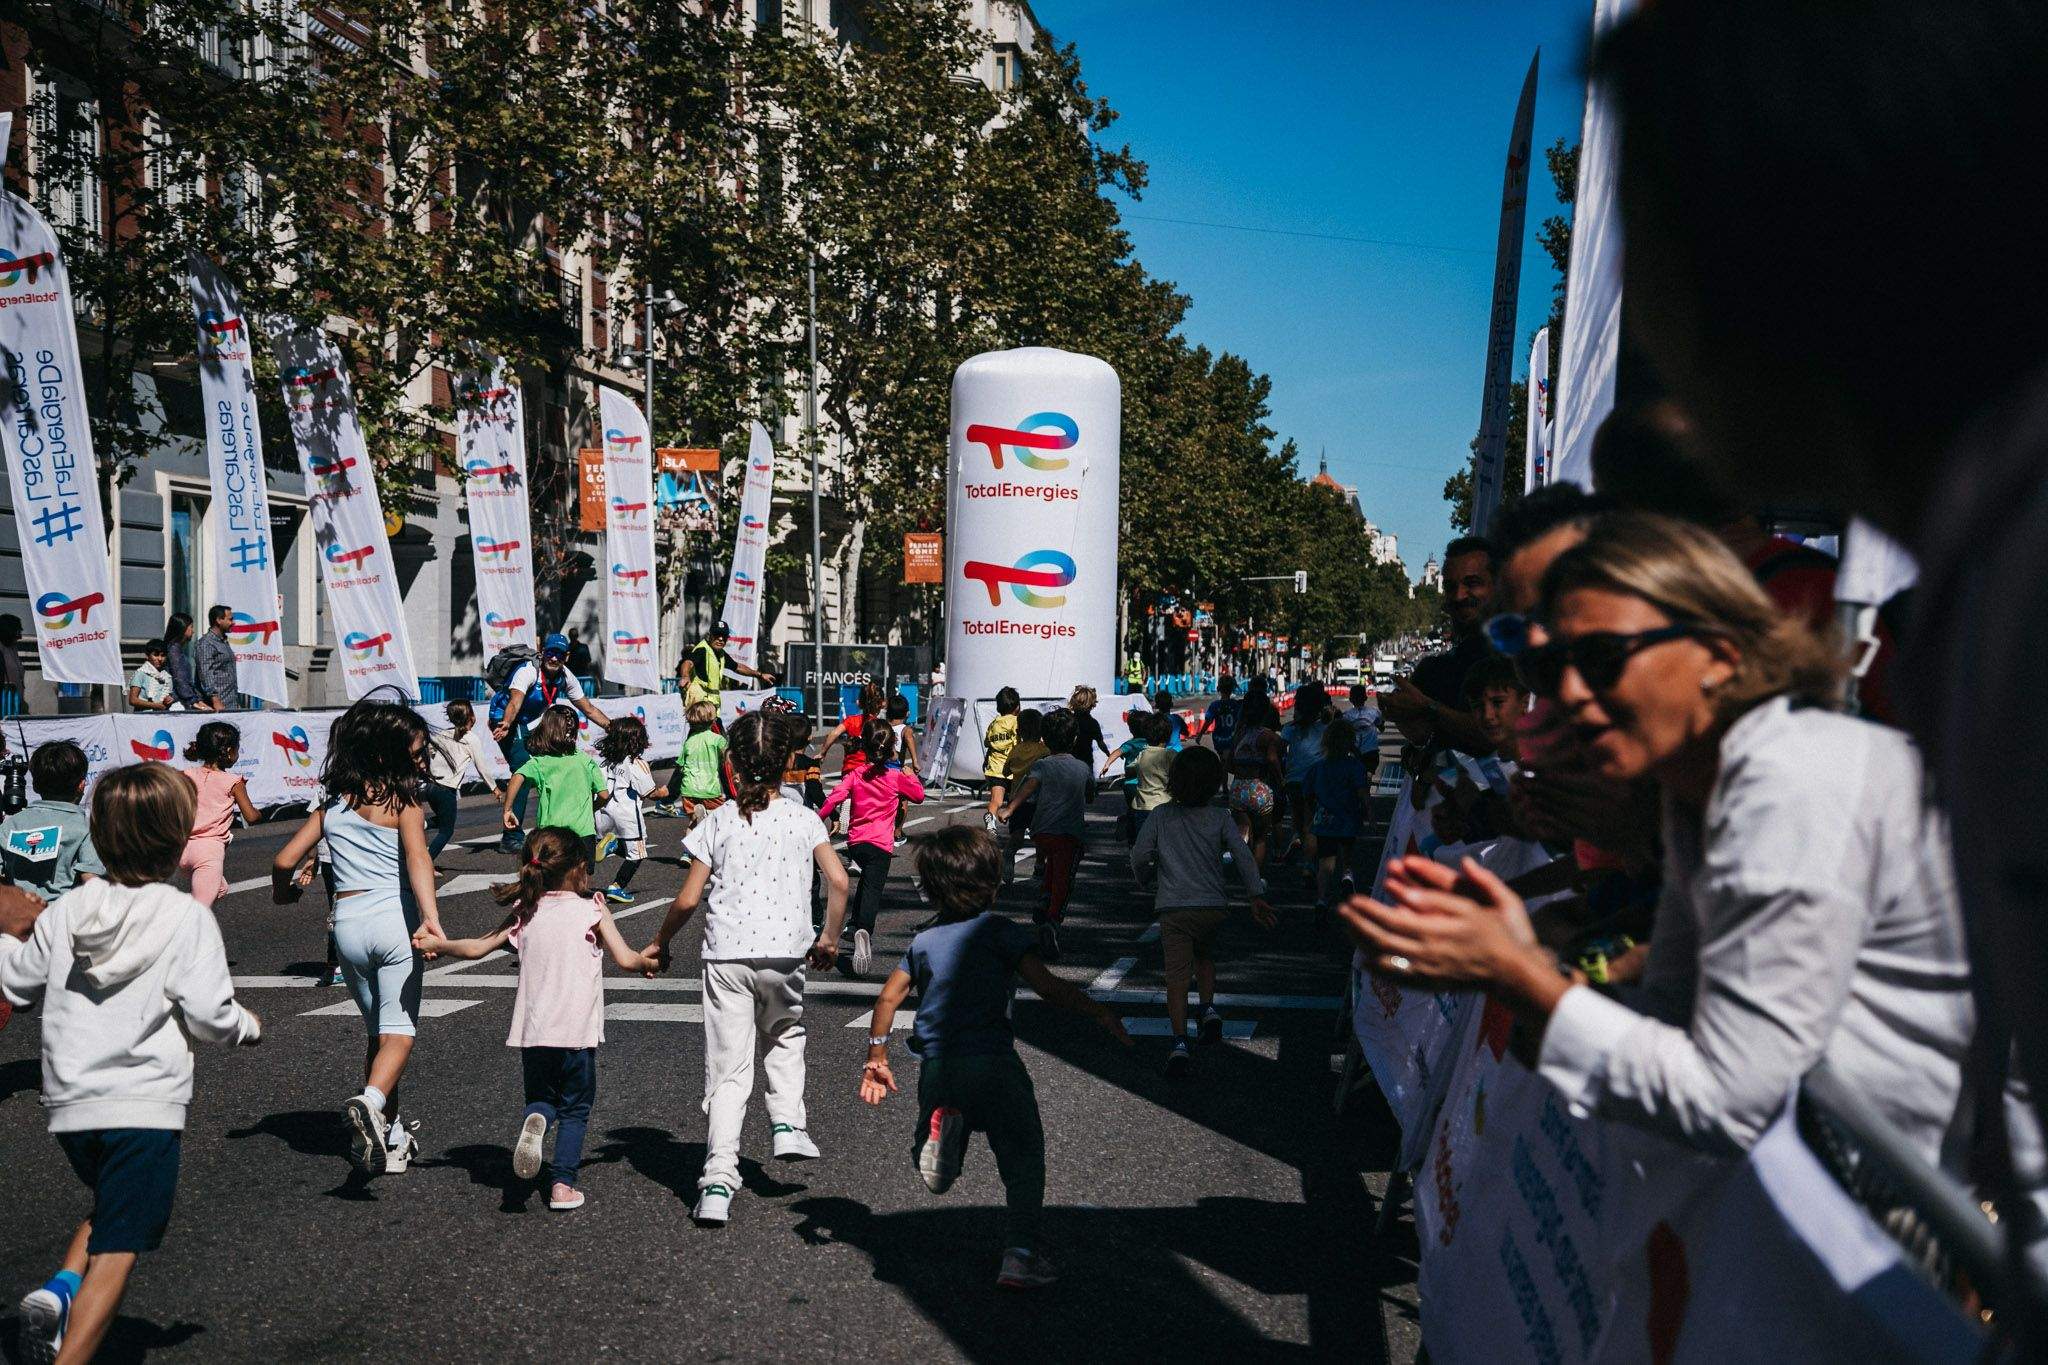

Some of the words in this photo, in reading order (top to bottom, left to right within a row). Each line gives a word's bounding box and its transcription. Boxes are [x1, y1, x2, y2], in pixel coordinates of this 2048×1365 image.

[965, 483, 1079, 502] TotalEnergies
[962, 620, 1076, 639] TotalEnergies
[805, 670, 871, 685] FANCÉS
